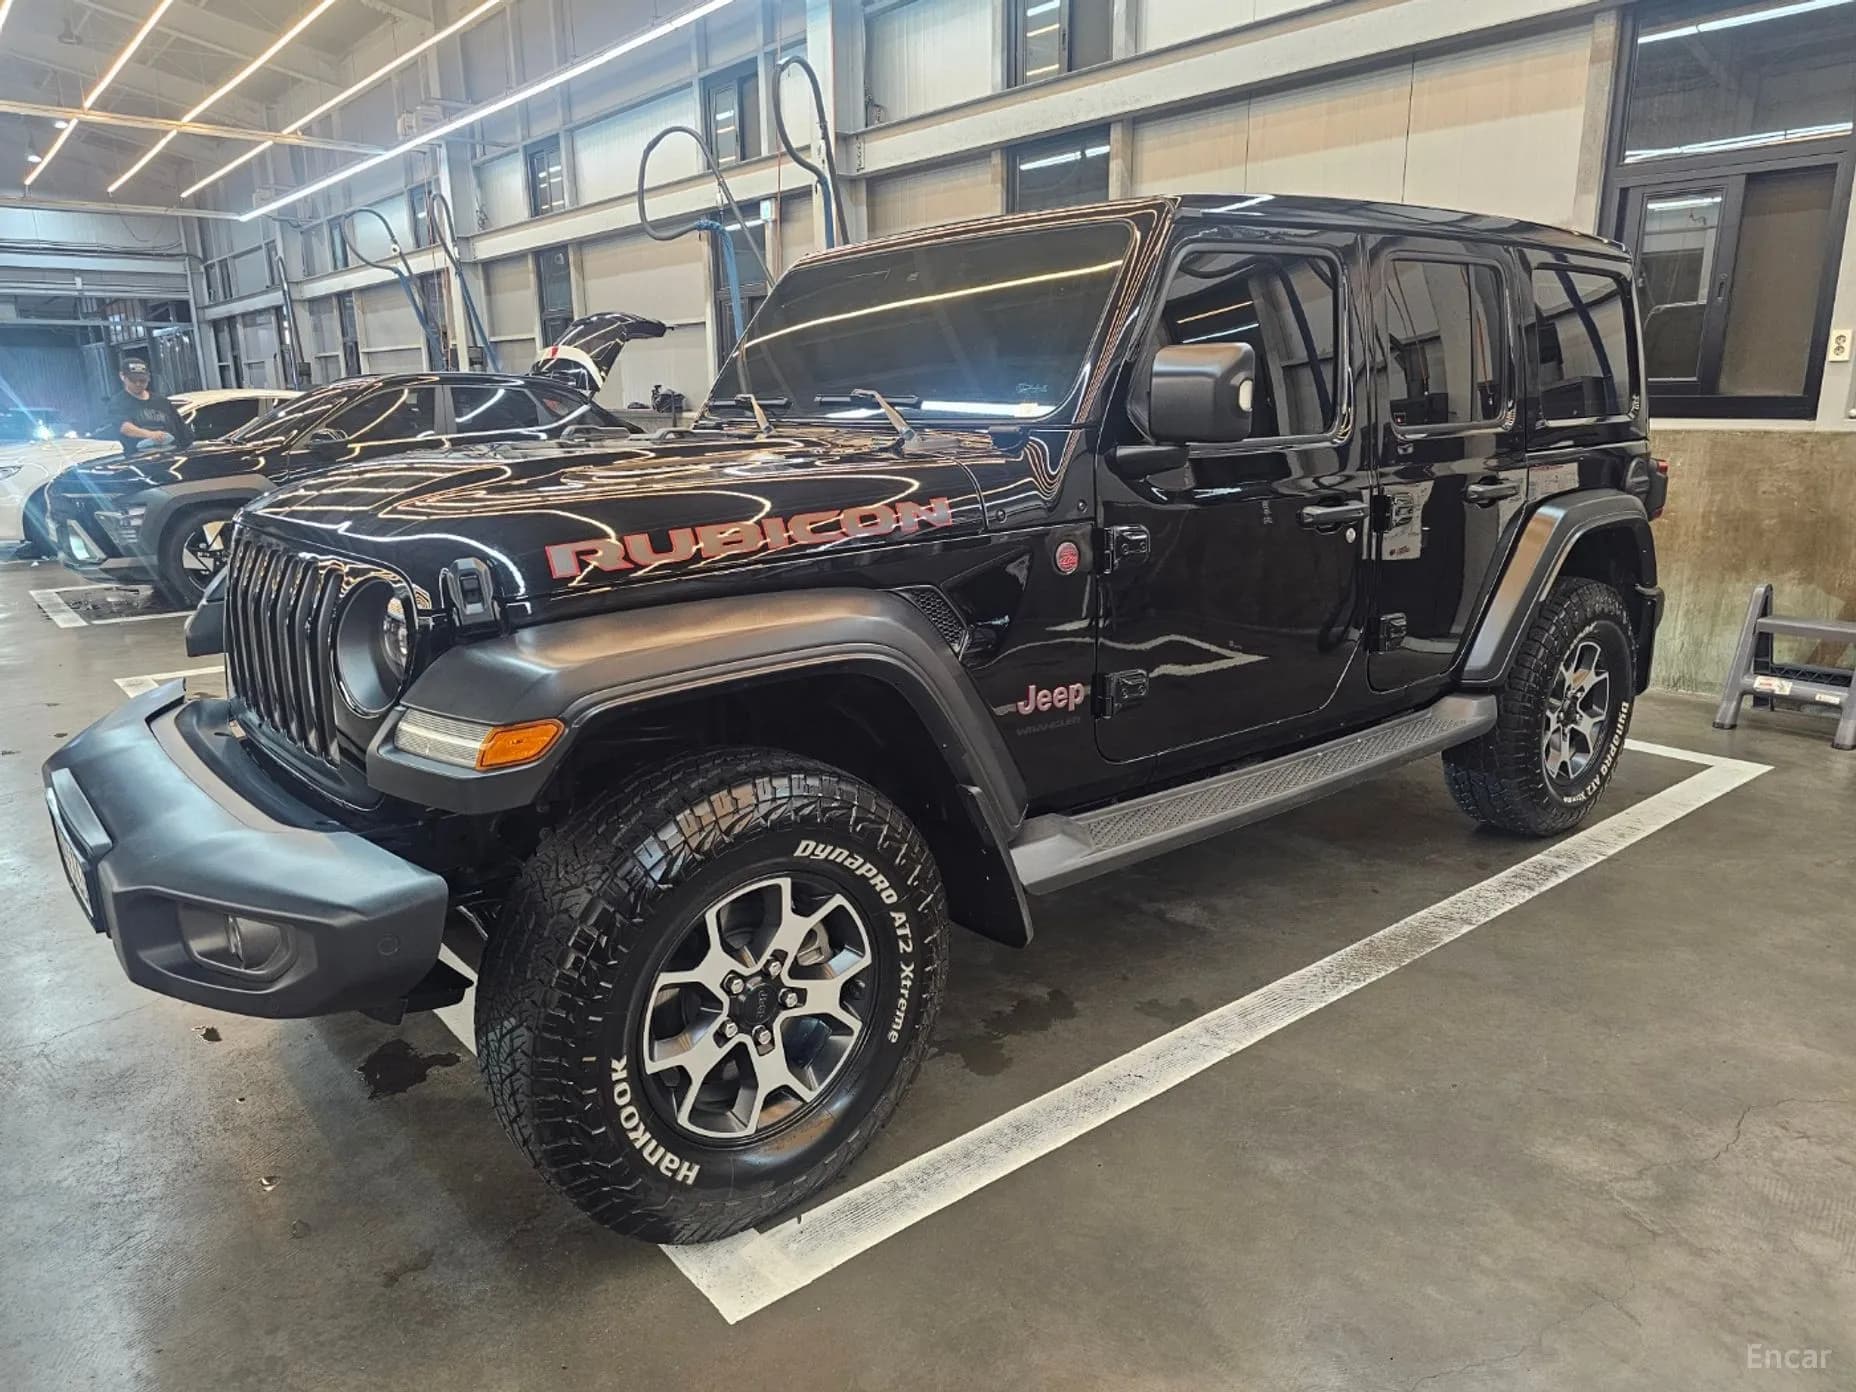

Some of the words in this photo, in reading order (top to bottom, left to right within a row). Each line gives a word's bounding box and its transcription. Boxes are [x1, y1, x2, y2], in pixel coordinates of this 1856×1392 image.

[544, 497, 952, 579] RUBICON
[1017, 683, 1085, 715] Jeep
[889, 911, 915, 953] AT2
[887, 961, 915, 1043] Xtreme
